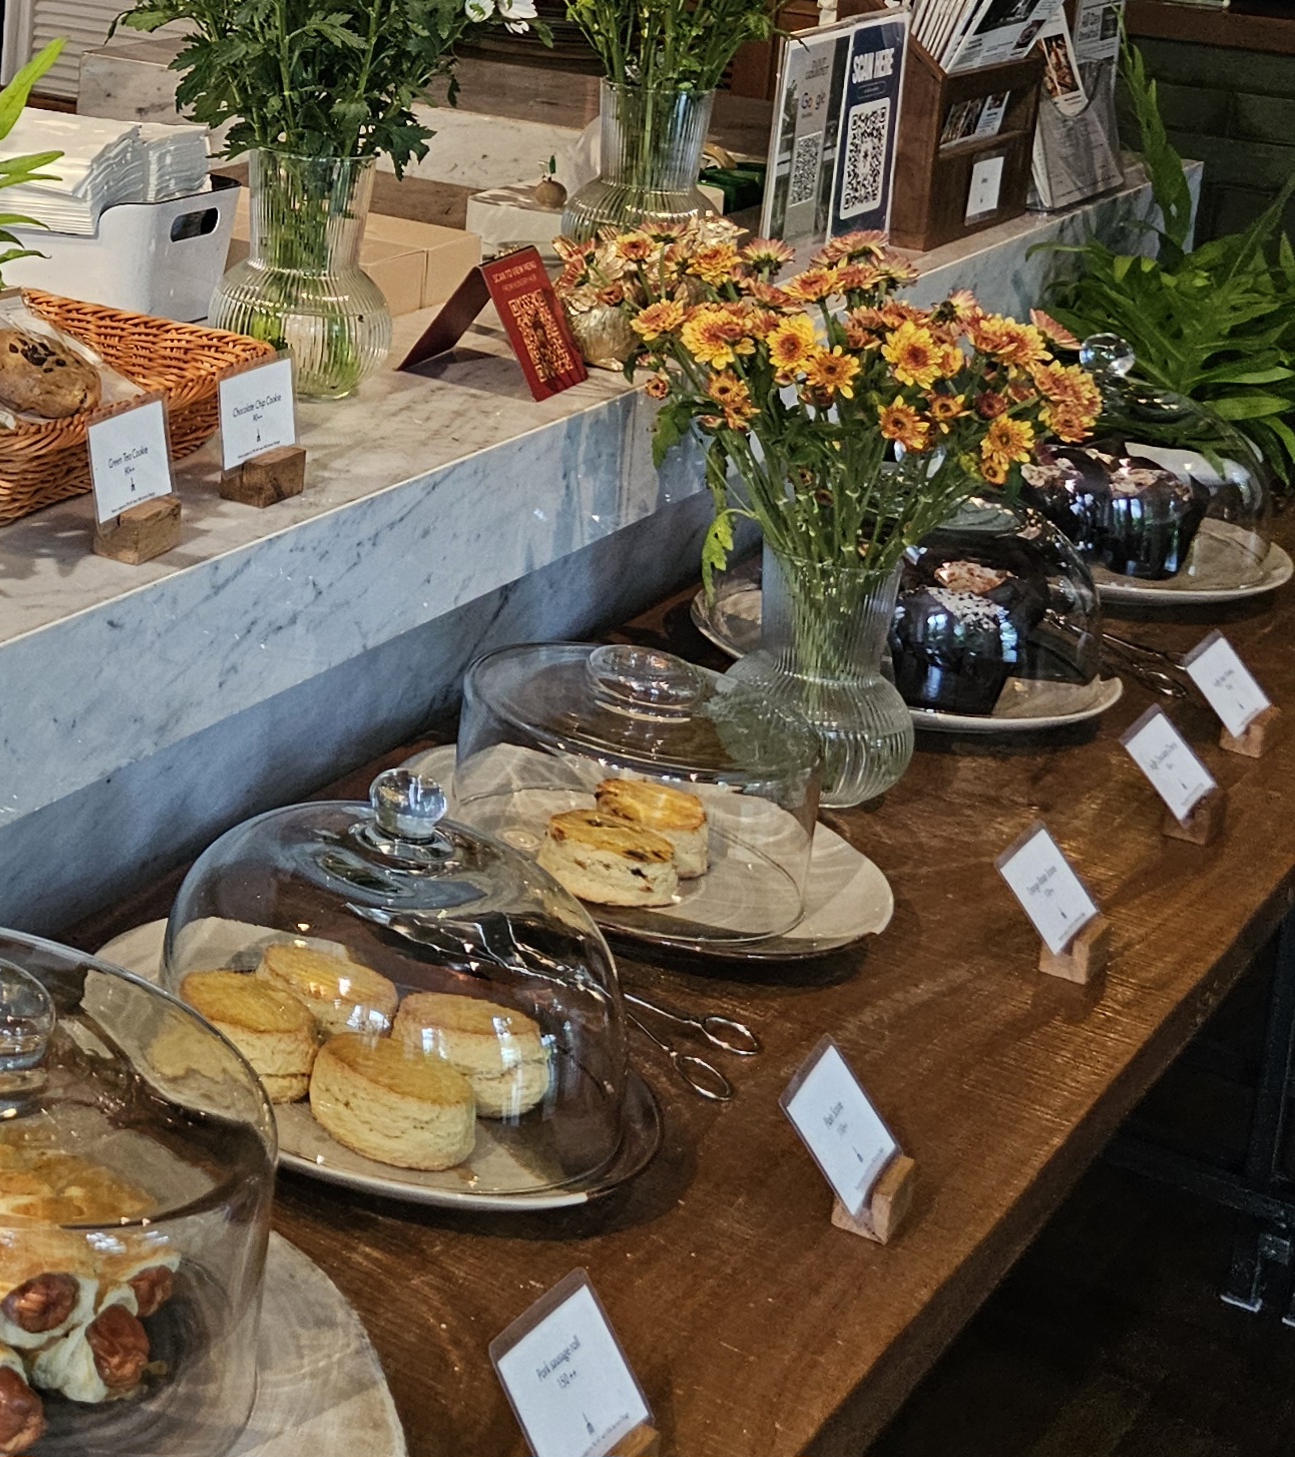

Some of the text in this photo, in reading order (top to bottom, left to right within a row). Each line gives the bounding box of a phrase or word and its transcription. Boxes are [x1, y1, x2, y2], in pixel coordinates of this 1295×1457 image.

[852, 48, 895, 84] SCAN HERE
[266, 392, 281, 404] Cookie
[108, 444, 148, 467] Green Tea Cookie
[535, 1359, 551, 1382] Pork
